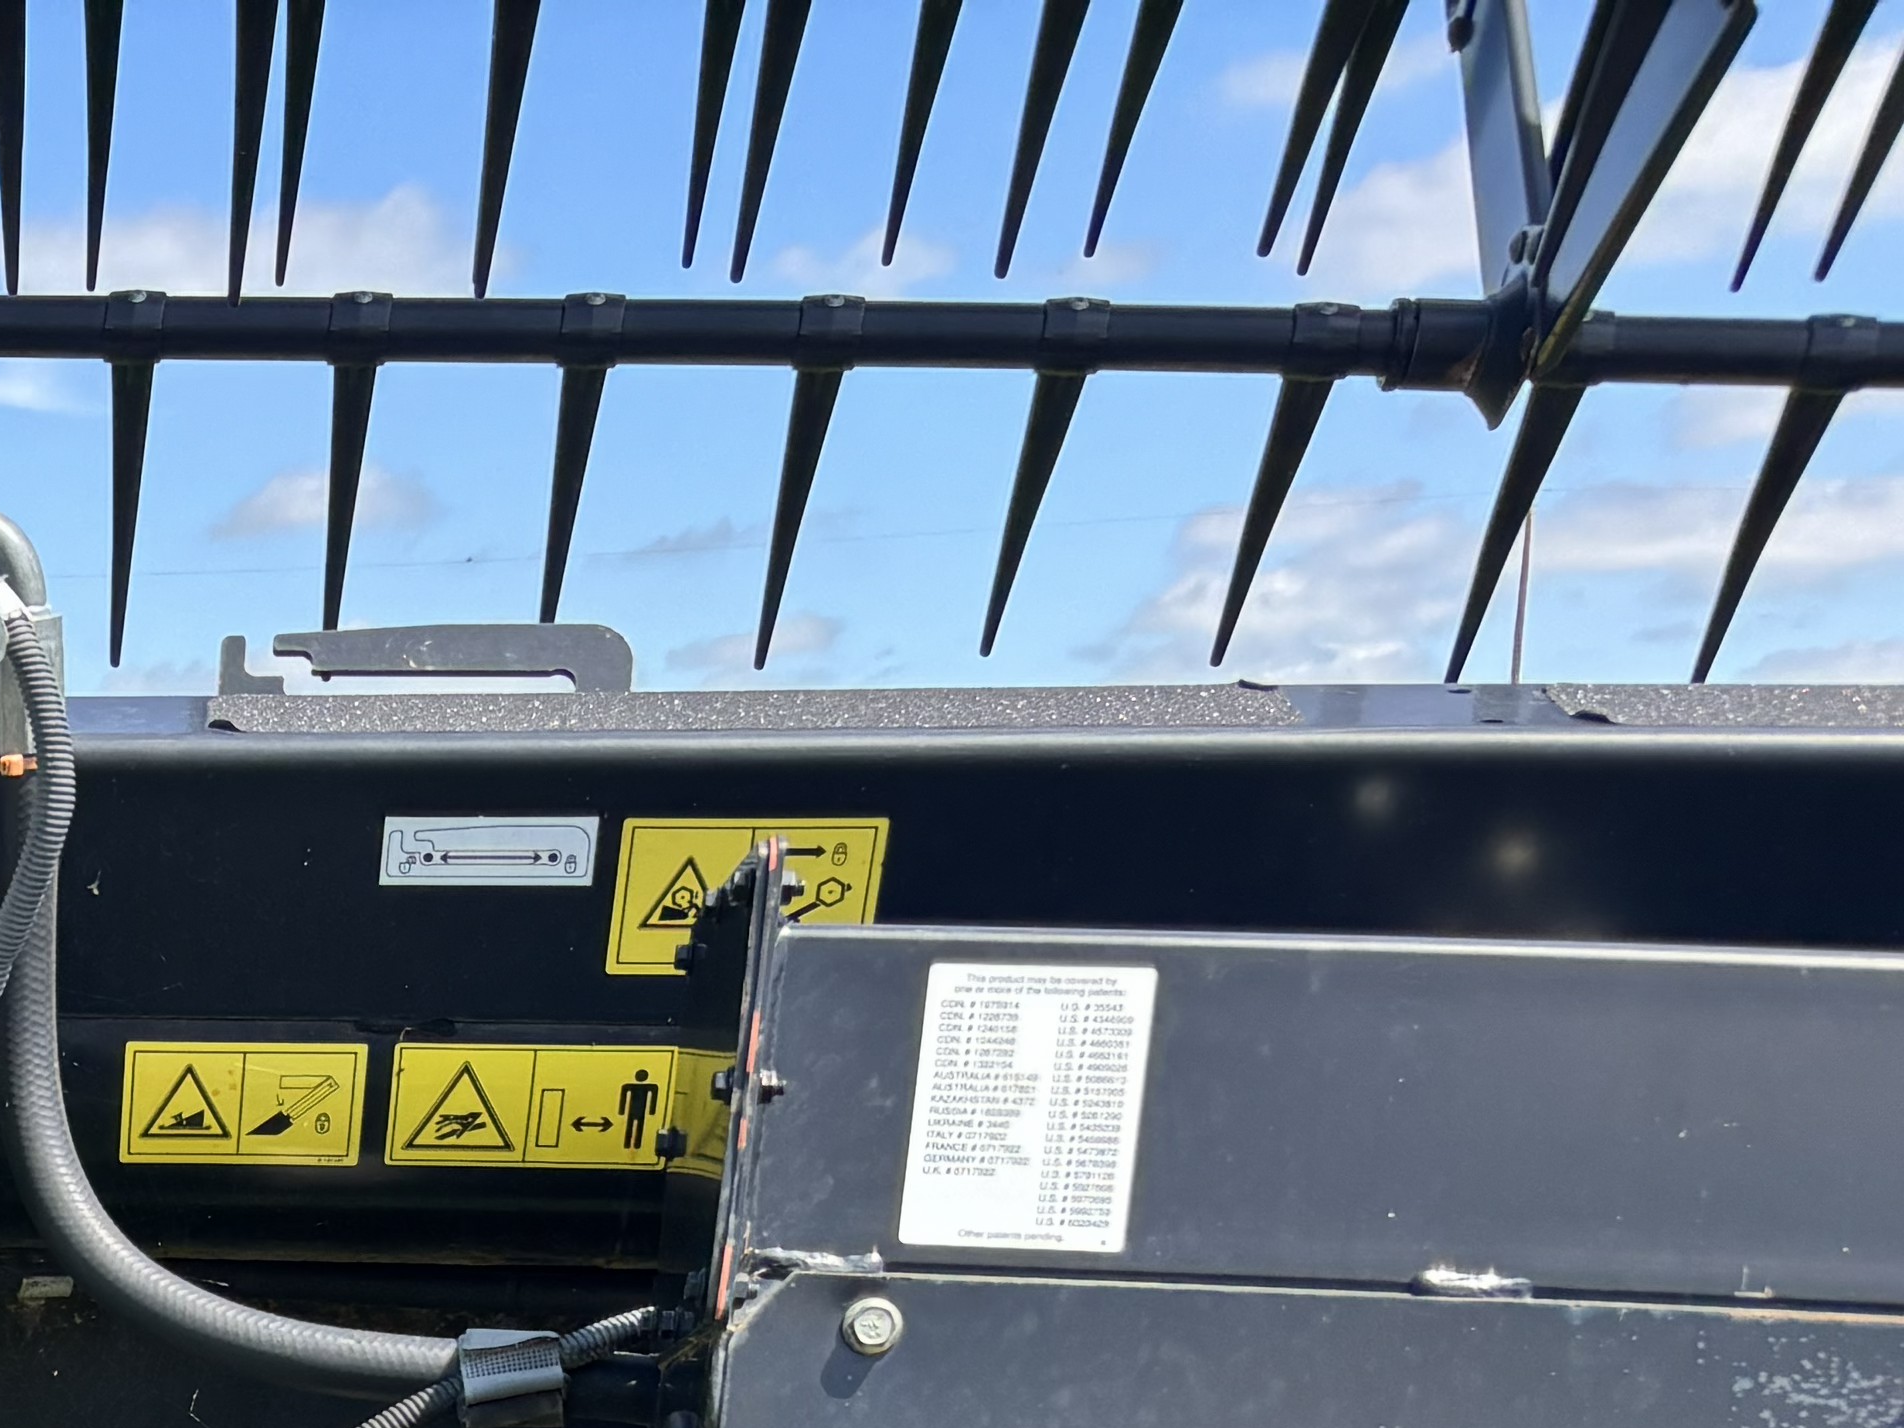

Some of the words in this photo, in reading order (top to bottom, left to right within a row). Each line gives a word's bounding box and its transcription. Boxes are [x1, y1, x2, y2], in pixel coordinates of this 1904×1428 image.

[989, 976, 1024, 984] product
[1027, 977, 1046, 985] may
[1050, 976, 1061, 984] be
[1106, 978, 1117, 987] by
[1015, 986, 1024, 994] of
[1044, 988, 1085, 997] following
[958, 1229, 983, 1238] Other
[987, 1231, 1021, 1240] patents
